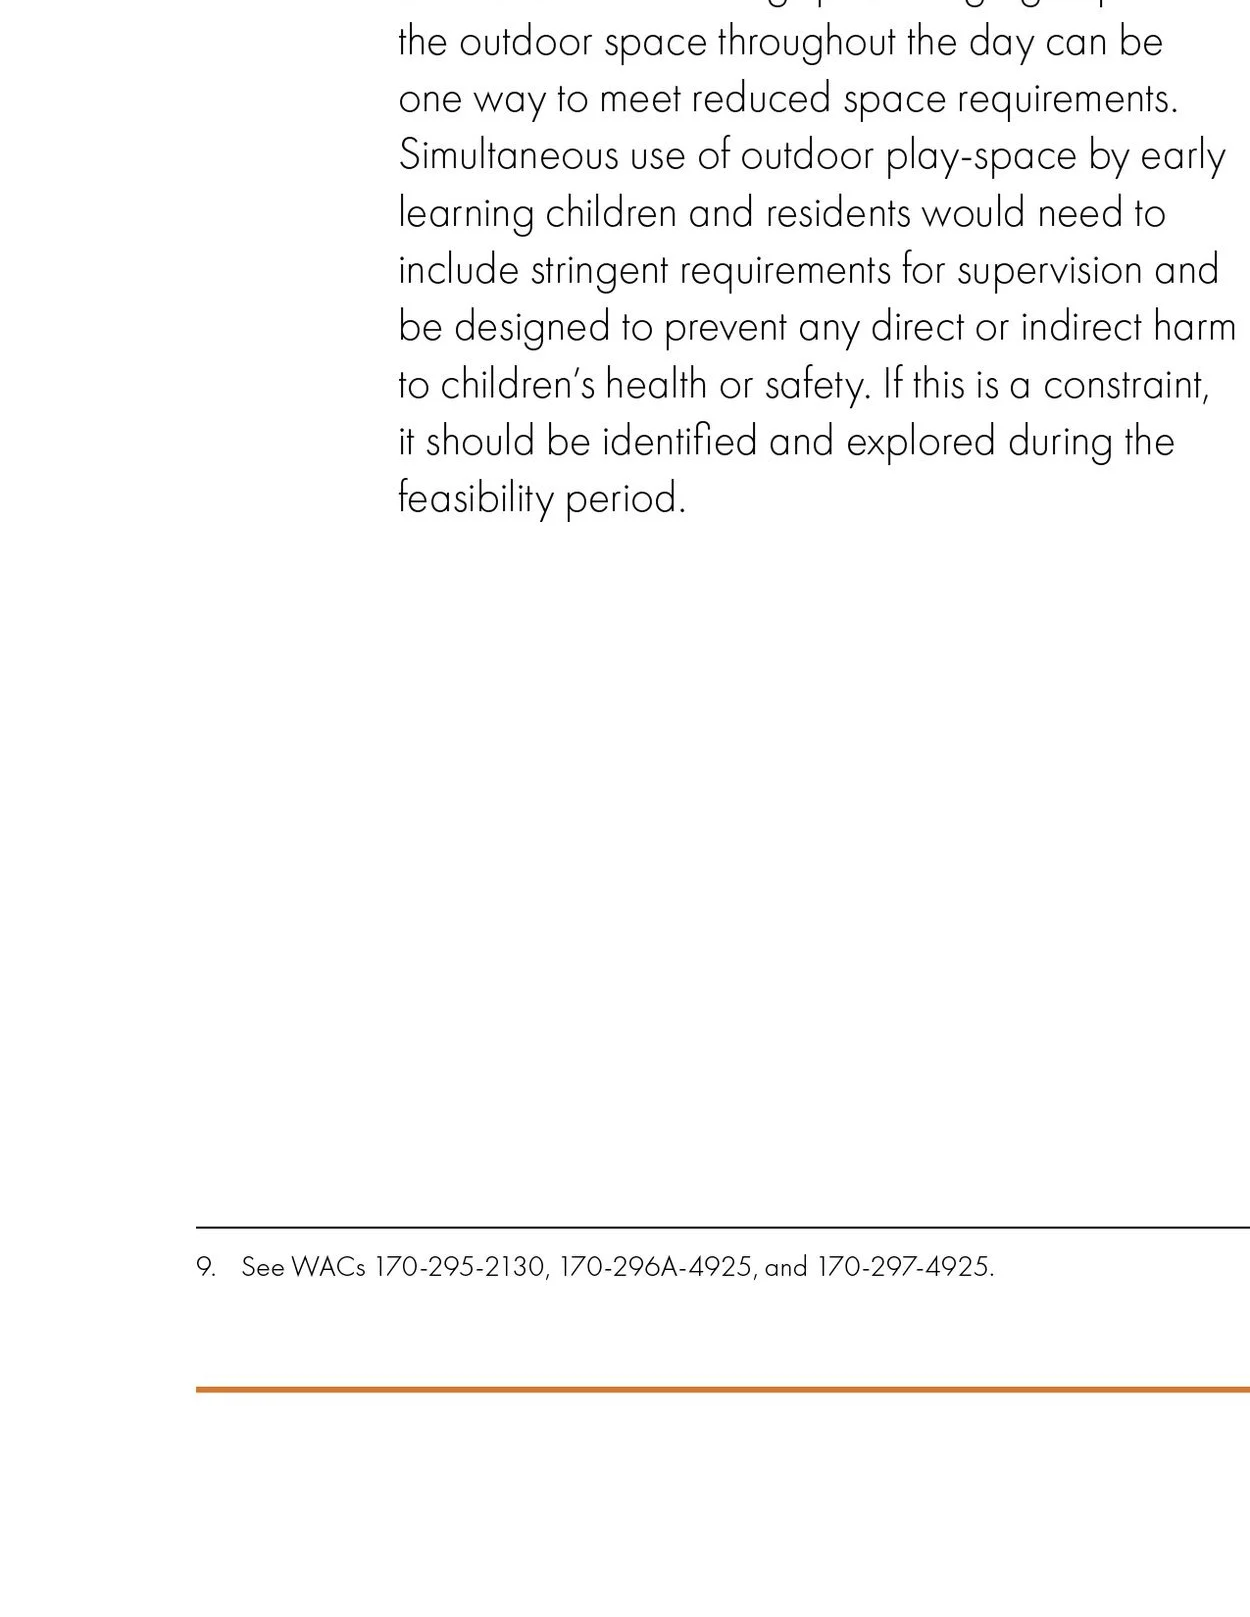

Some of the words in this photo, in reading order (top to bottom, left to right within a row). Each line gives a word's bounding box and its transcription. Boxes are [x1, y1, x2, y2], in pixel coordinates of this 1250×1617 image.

[399, 90, 462, 113] one
[472, 91, 547, 123] way
[557, 85, 588, 113] to
[601, 85, 682, 113] meet
[693, 78, 830, 113] reduced
[843, 90, 946, 123] space
[959, 84, 1178, 123] requirements.
[399, 249, 519, 285] include
[531, 255, 669, 295] stringent
[681, 255, 891, 295] requirements
[902, 248, 946, 285] for
[957, 255, 1142, 295] supervision
[1155, 249, 1218, 285] and
[398, 371, 430, 400] to
[607, 364, 706, 400] health
[719, 377, 754, 400] or
[765, 363, 871, 409] safety.
[885, 363, 904, 399] If
[913, 364, 965, 400] this
[976, 370, 999, 400] is
[1010, 377, 1030, 400] a
[1044, 370, 1209, 405] constraint,
[398, 477, 555, 523] feasibility
[566, 478, 685, 523] period.
[196, 1255, 216, 1277] 9.
[241, 1255, 285, 1277] See
[291, 1254, 366, 1277] WACs
[376, 1255, 550, 1281] 170-295-2130,
[561, 1254, 758, 1281] 170-296A-4925,
[764, 1253, 807, 1277] and
[819, 1254, 994, 1277] 170-297-4925.
